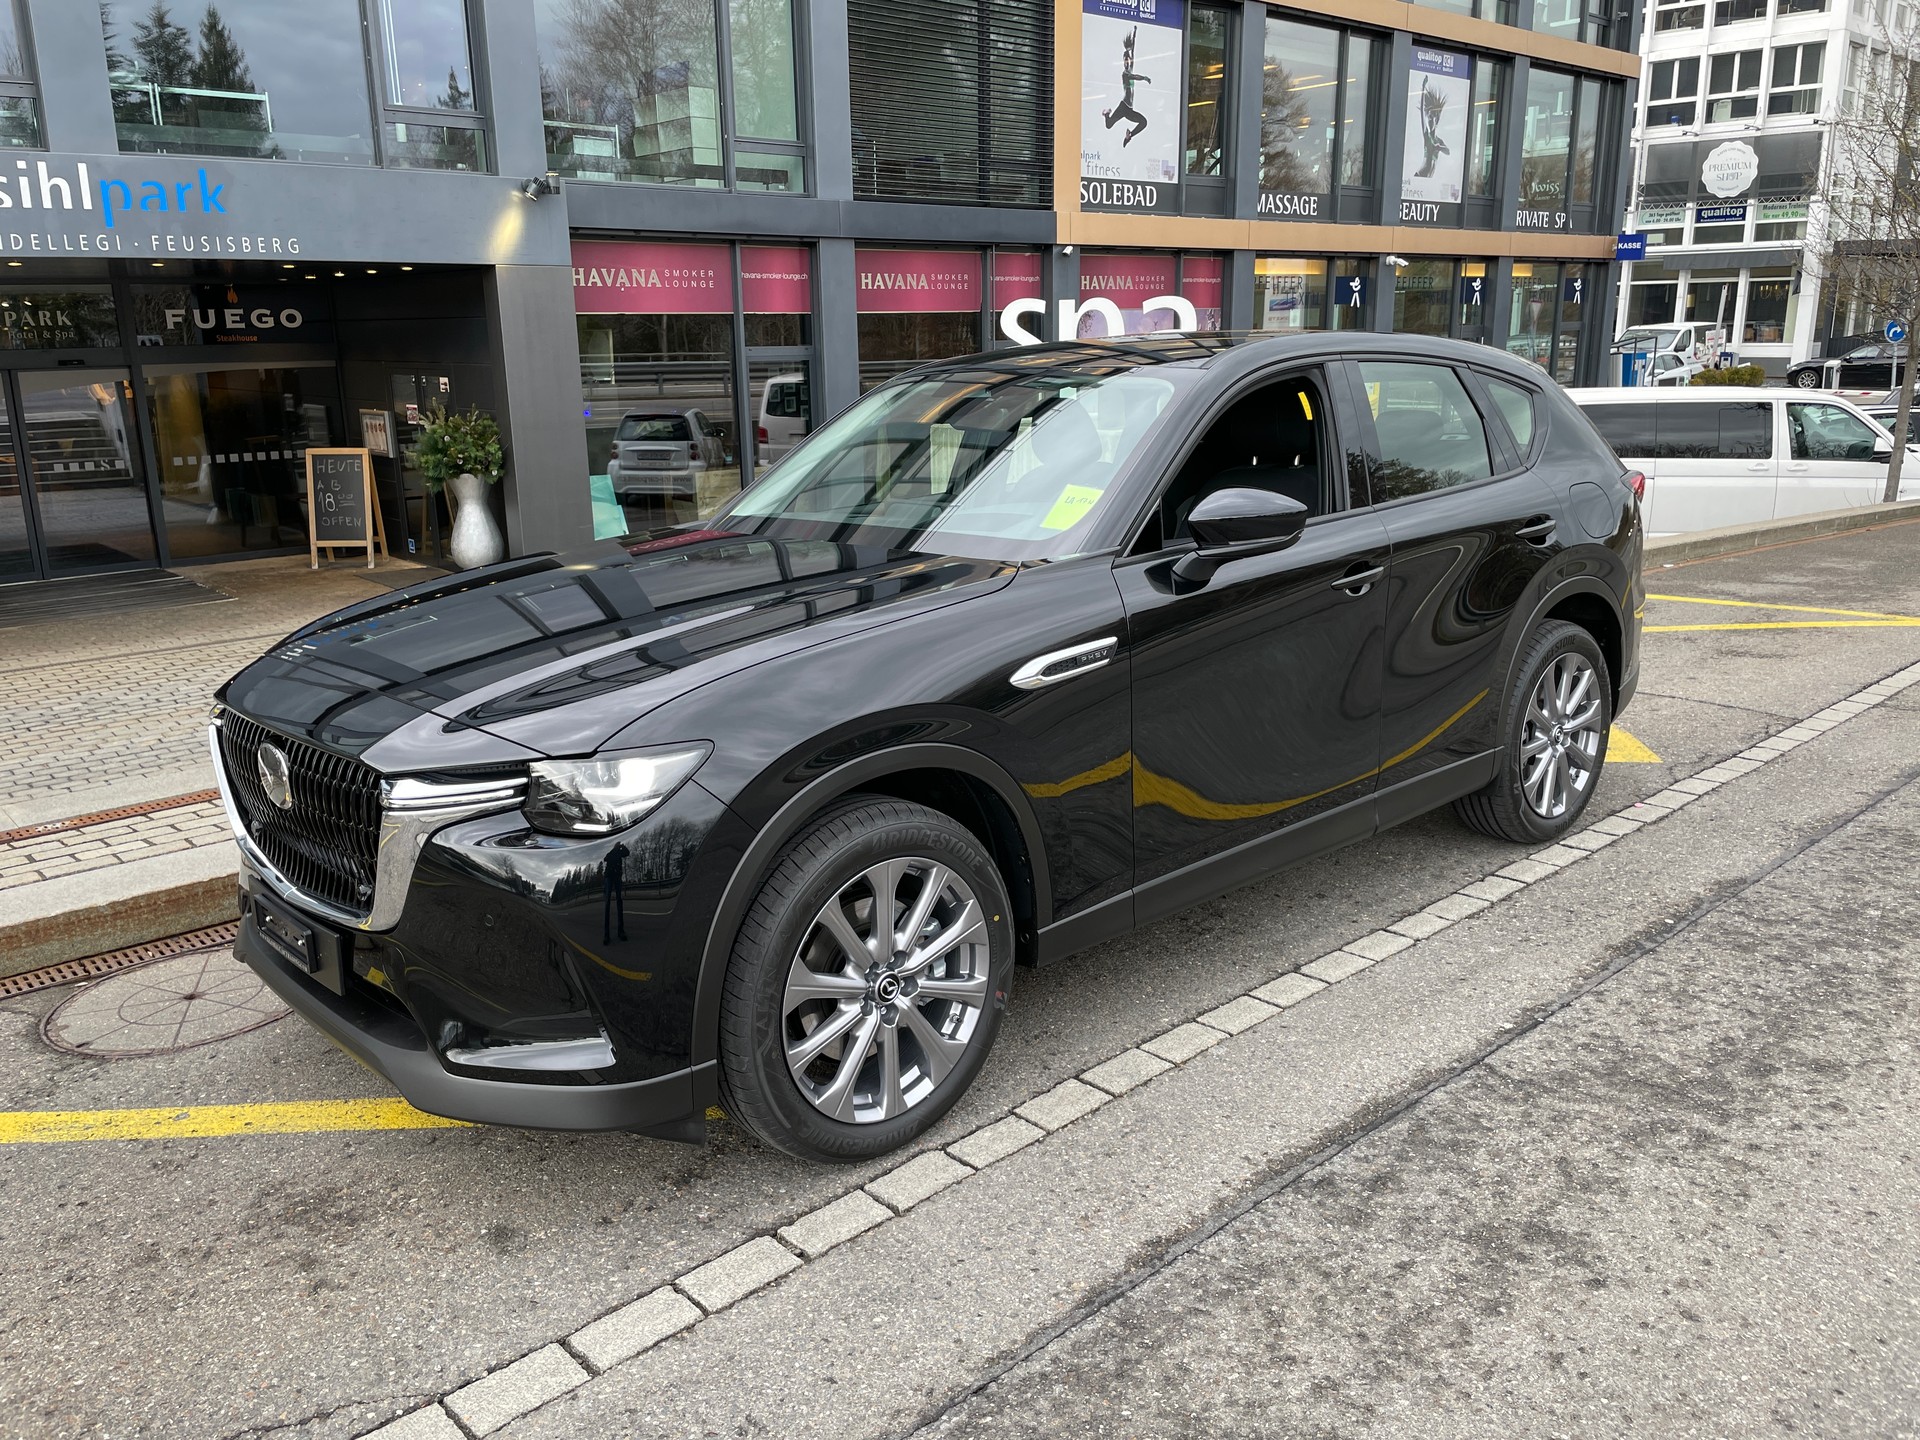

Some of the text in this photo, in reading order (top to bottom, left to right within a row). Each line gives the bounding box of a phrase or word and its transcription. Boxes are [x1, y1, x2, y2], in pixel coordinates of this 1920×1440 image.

[1086, 161, 1121, 177] fitness
[1708, 161, 1752, 172] PREMIUM
[1080, 181, 1157, 207] SOLEBAD
[1257, 193, 1318, 216] MASSAGE
[1701, 207, 1744, 218] qualitop
[152, 235, 300, 254] FEUSISBERG
[1617, 242, 1642, 250] KASSE
[572, 267, 662, 288] HAVANA
[664, 269, 715, 278] SMOKER
[860, 272, 930, 290] HAVANA
[931, 273, 969, 281] SMOKER
[664, 279, 715, 289] LOUNGE
[931, 282, 969, 290] LOUNGE
[1081, 275, 1133, 290] HAVANA
[4, 310, 73, 328] PARK
[164, 307, 303, 330] FUEGO
[43, 330, 51, 339] &
[55, 330, 75, 341] Spa
[216, 333, 258, 343] Steakhouse
[316, 459, 361, 474] HEUTE
[322, 516, 362, 528] OFFEN
[871, 828, 983, 871] BRIDGESTONE
